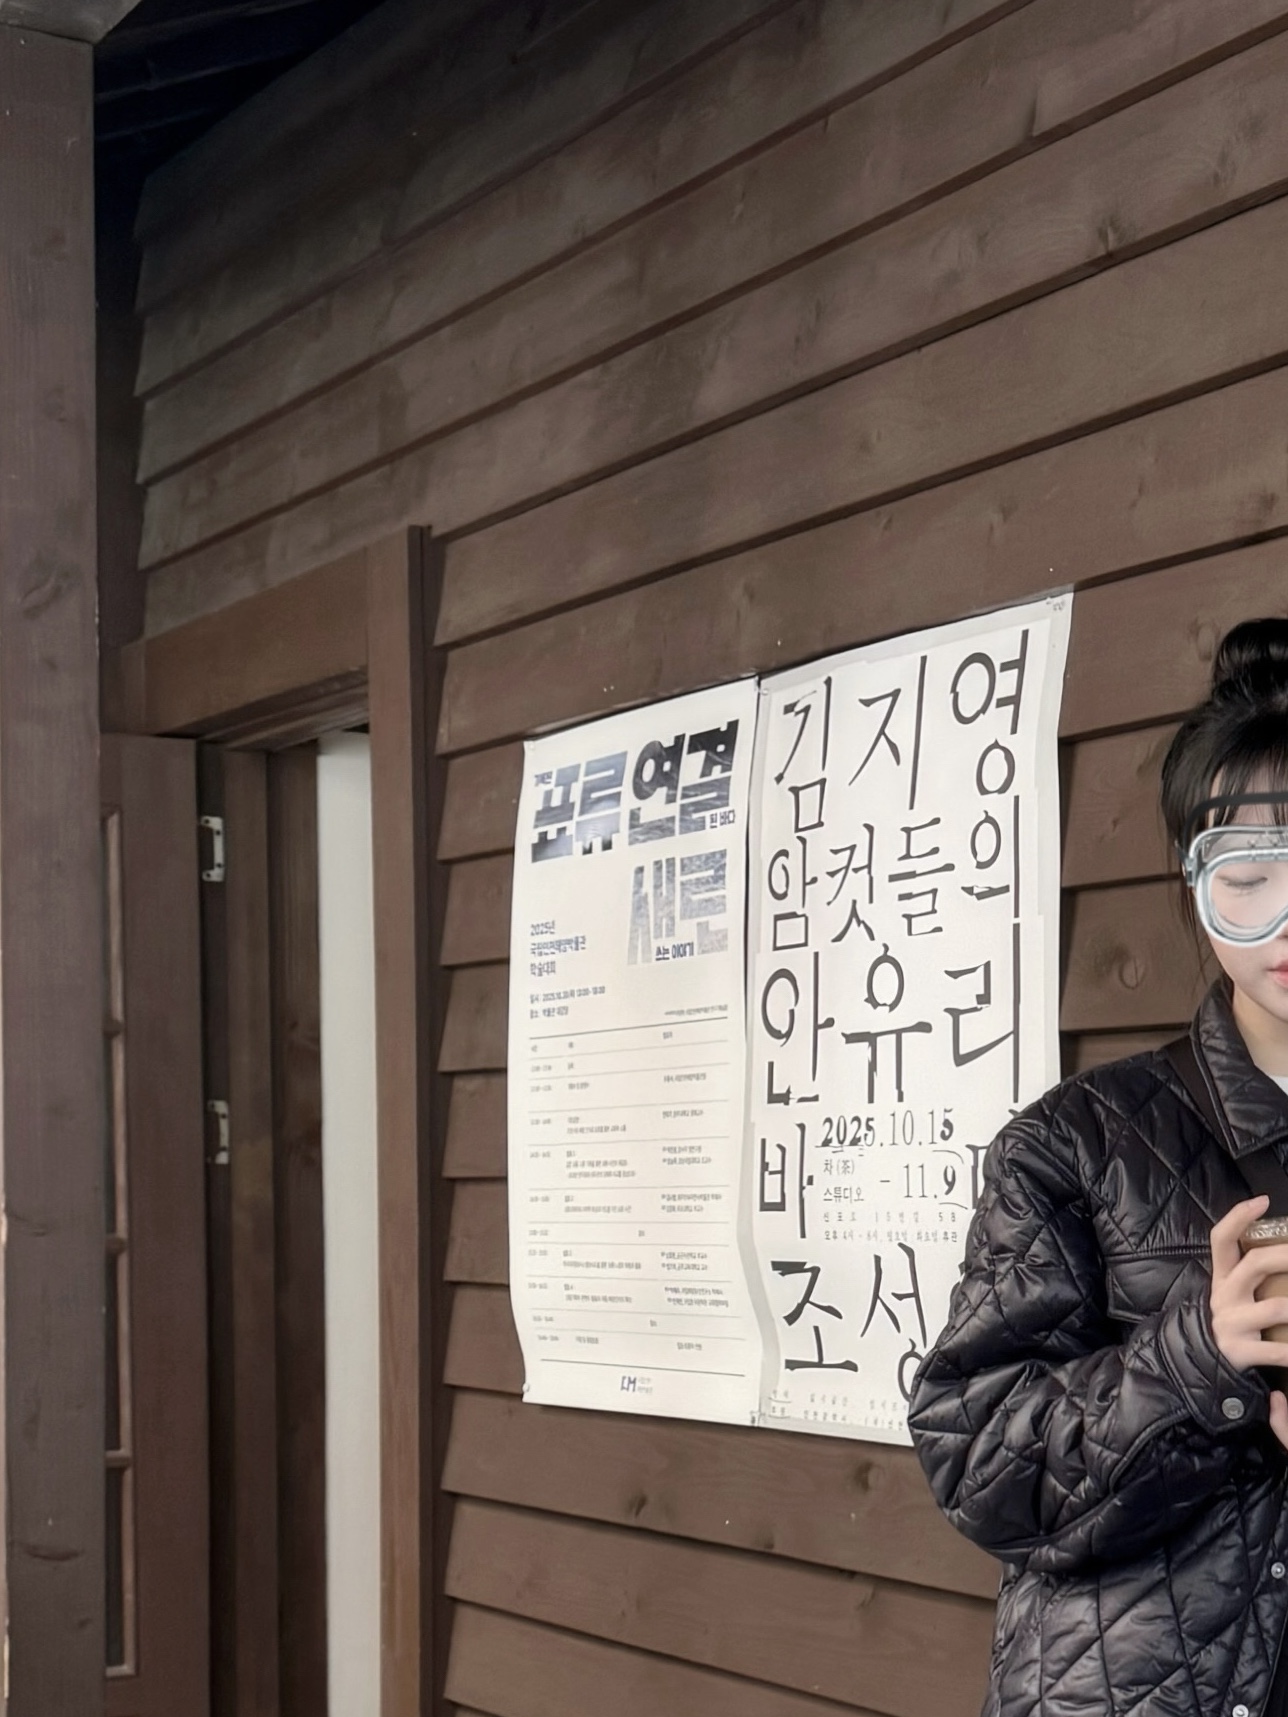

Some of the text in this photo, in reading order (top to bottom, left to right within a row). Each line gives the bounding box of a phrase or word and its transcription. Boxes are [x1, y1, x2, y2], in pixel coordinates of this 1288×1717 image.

[774, 629, 1029, 833] 김지영
[672, 942, 695, 959] 이야기
[768, 795, 1020, 951] 암컷들의
[761, 923, 1020, 1105] 안유리
[821, 1108, 954, 1147] 2025.10.15
[823, 1186, 865, 1203] 스튜디오
[770, 1242, 966, 1403] 조성
